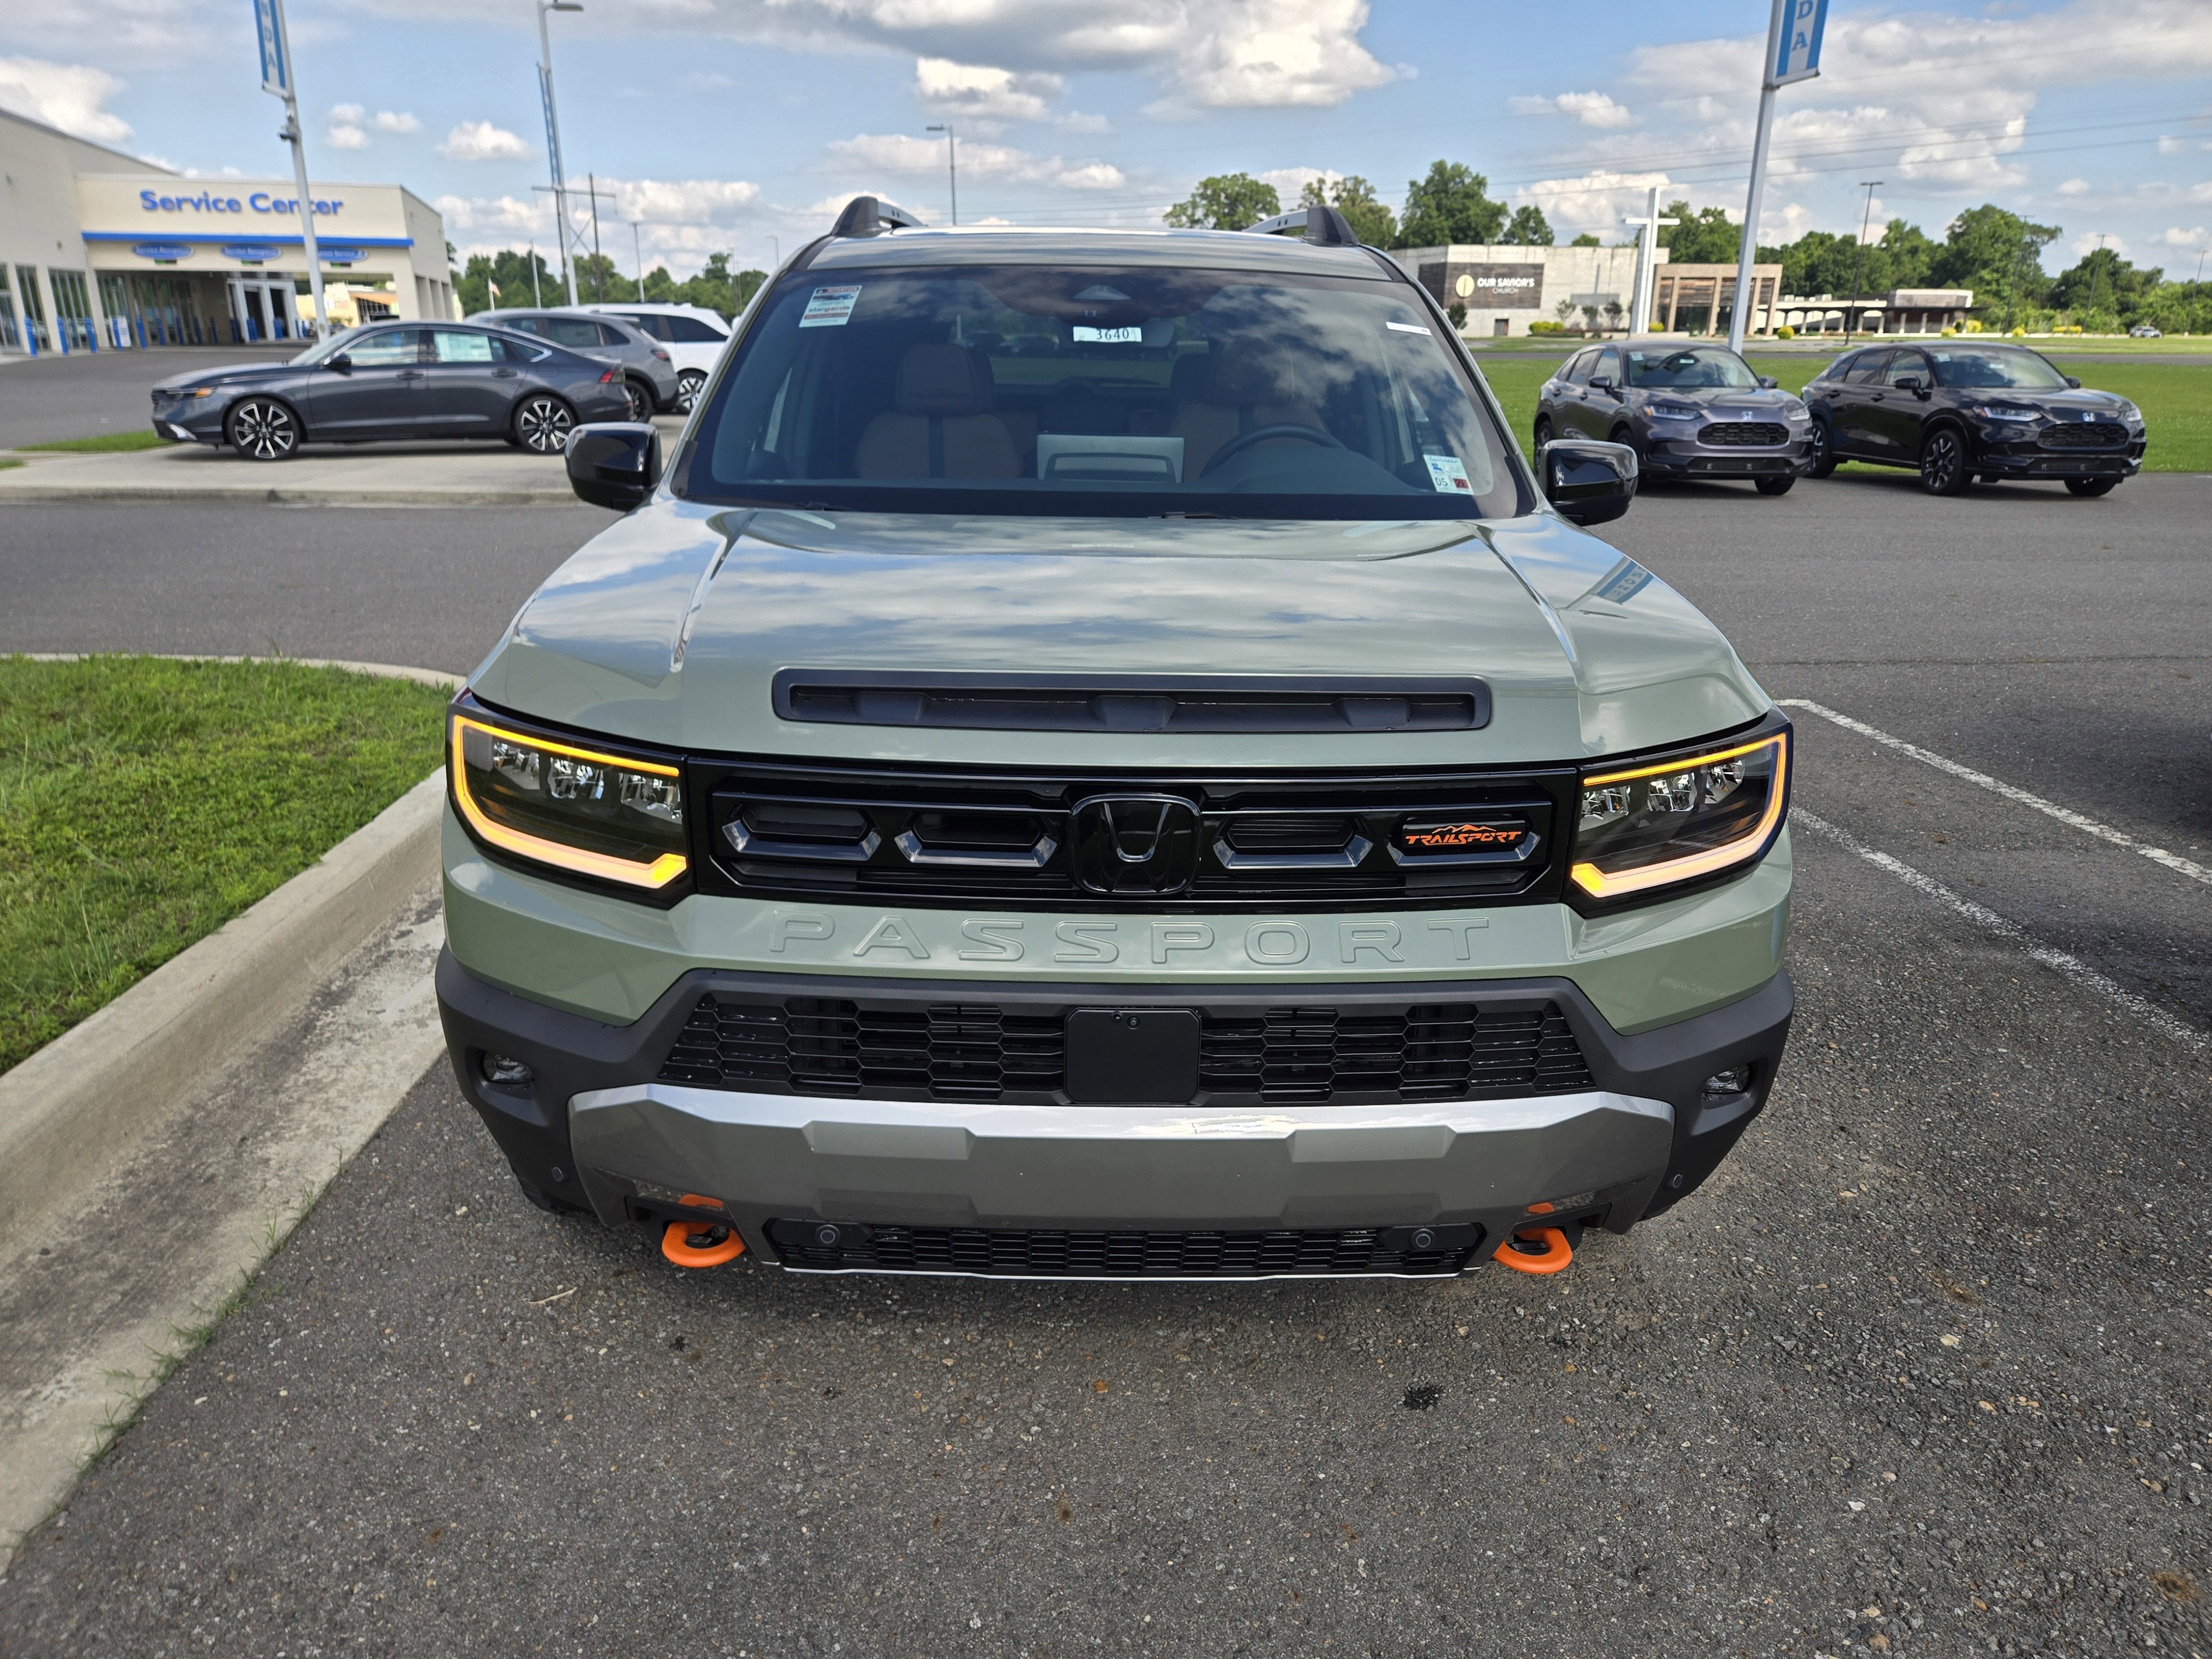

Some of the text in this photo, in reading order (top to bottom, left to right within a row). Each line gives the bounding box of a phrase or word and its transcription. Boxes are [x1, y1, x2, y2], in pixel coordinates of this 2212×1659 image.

[139, 190, 242, 212] Service
[1477, 277, 1535, 288] OUR SAVIOR'S
[1096, 328, 1129, 340] 3640
[1435, 477, 1448, 487] 05
[1405, 831, 1522, 846] TRAILSPORT
[769, 910, 1490, 966] PASSPORT
